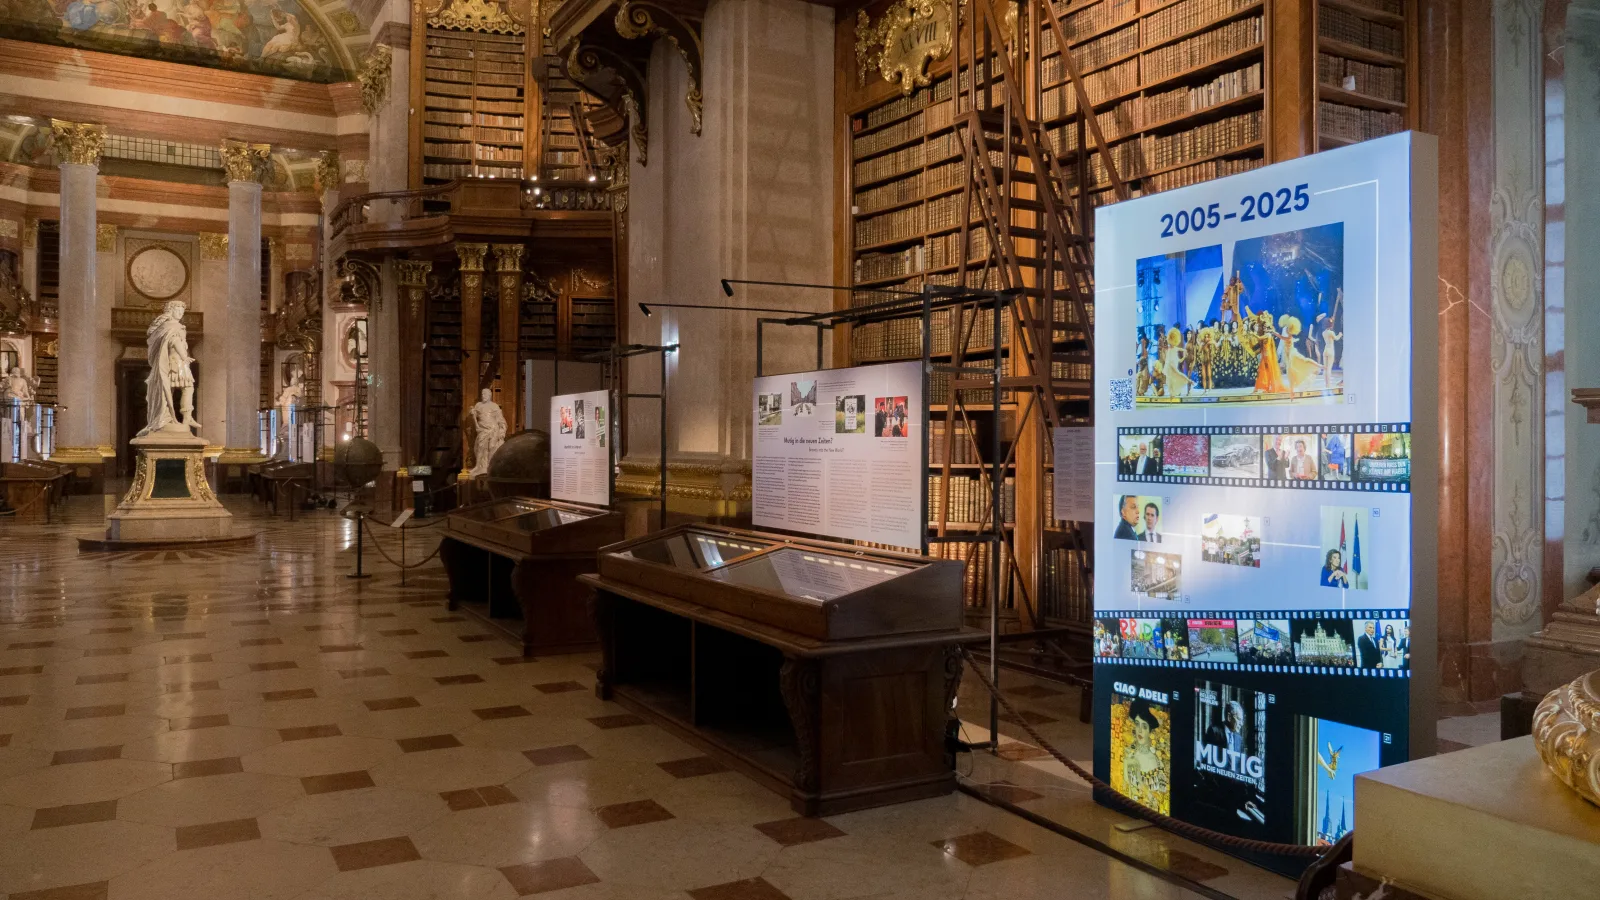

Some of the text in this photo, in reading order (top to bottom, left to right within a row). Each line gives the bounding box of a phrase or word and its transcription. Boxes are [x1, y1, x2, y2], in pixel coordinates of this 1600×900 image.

[784, 437, 795, 445] Mutig
[1113, 681, 1136, 696] CIAO
[1138, 687, 1169, 704] ADELE
[1195, 740, 1263, 777] MUTIG
[1206, 765, 1216, 773] DIE
[1216, 768, 1236, 779] NEUEN
